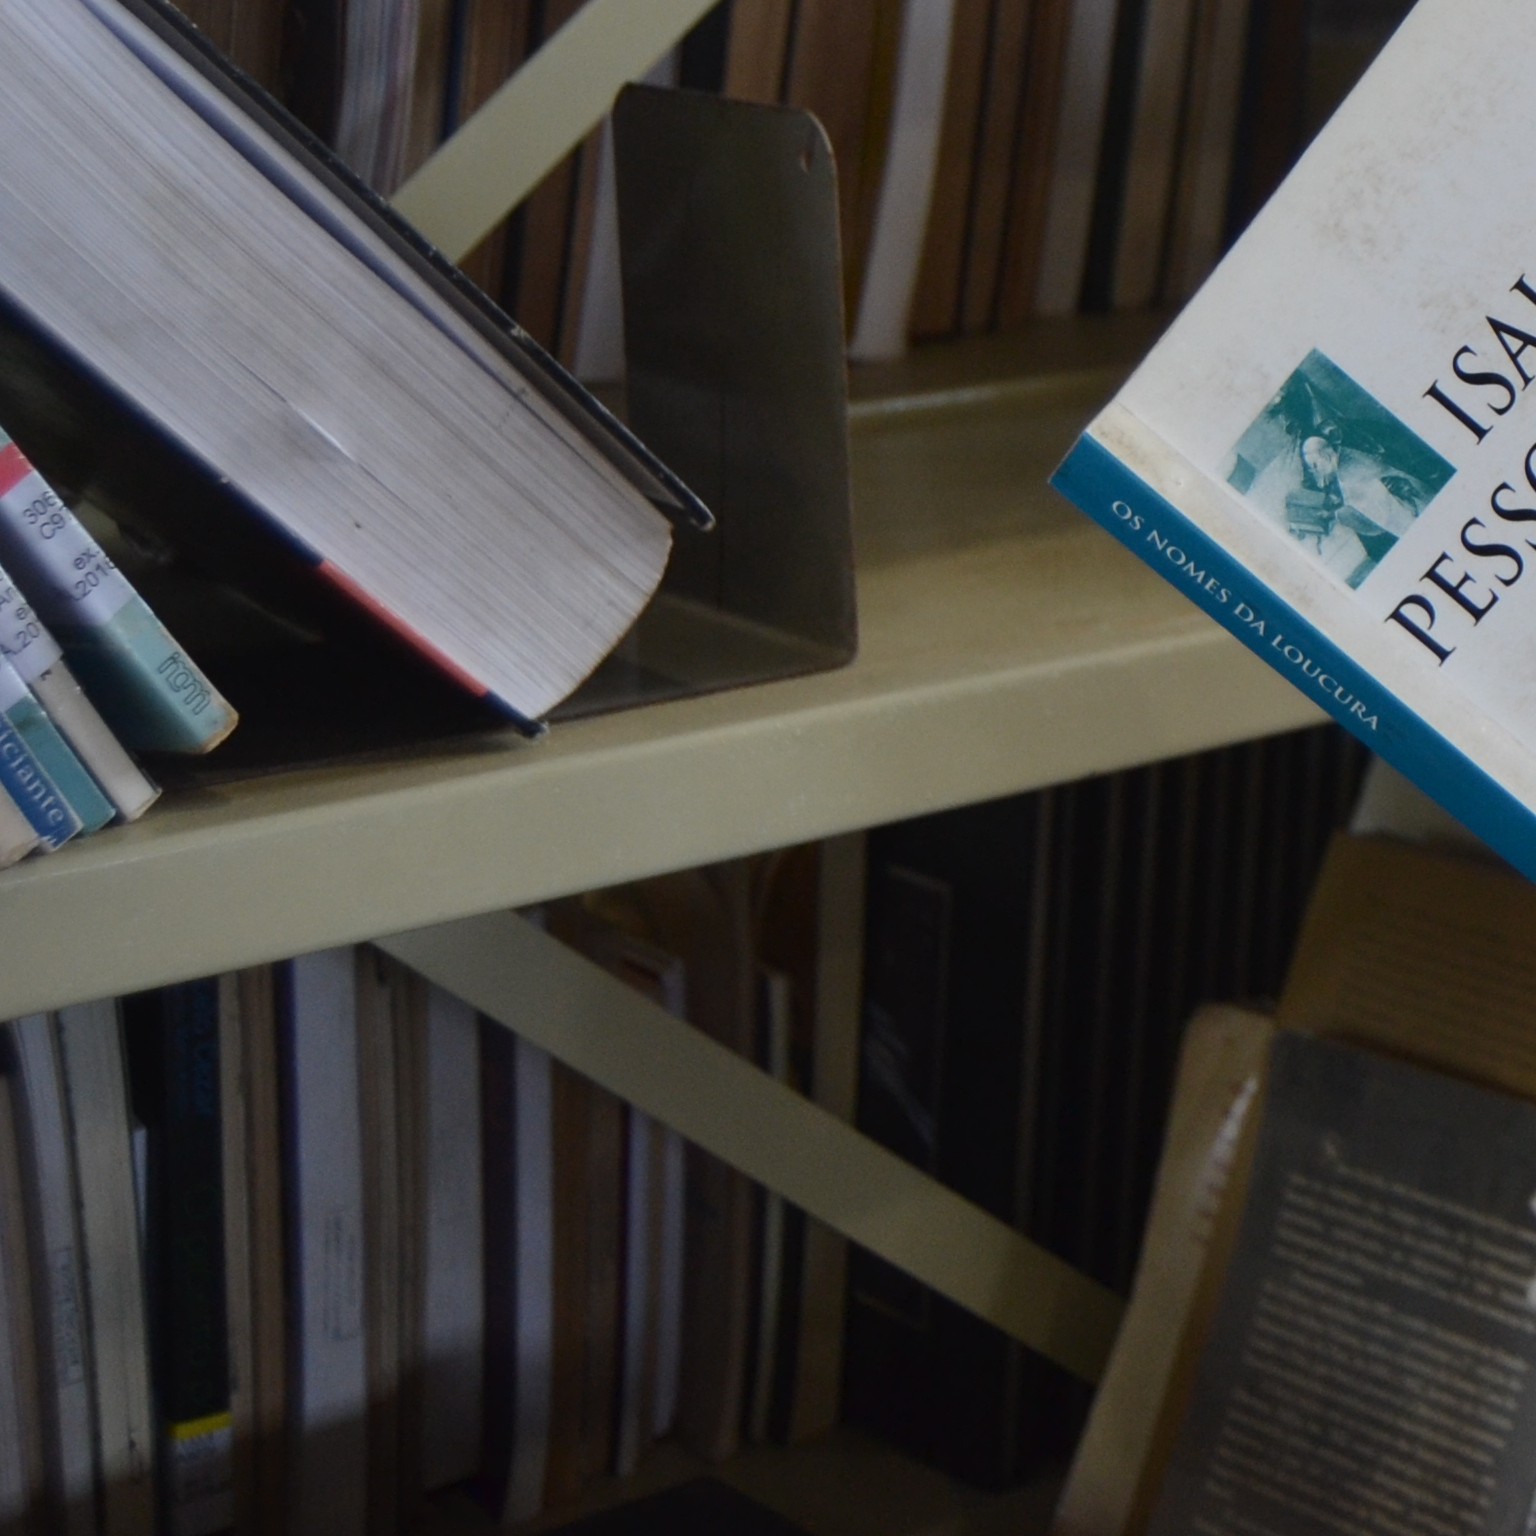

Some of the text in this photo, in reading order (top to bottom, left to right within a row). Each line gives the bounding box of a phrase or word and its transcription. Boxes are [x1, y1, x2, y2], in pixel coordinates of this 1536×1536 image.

[1111, 500, 1380, 731] OS NOMES DA LOUCURA
